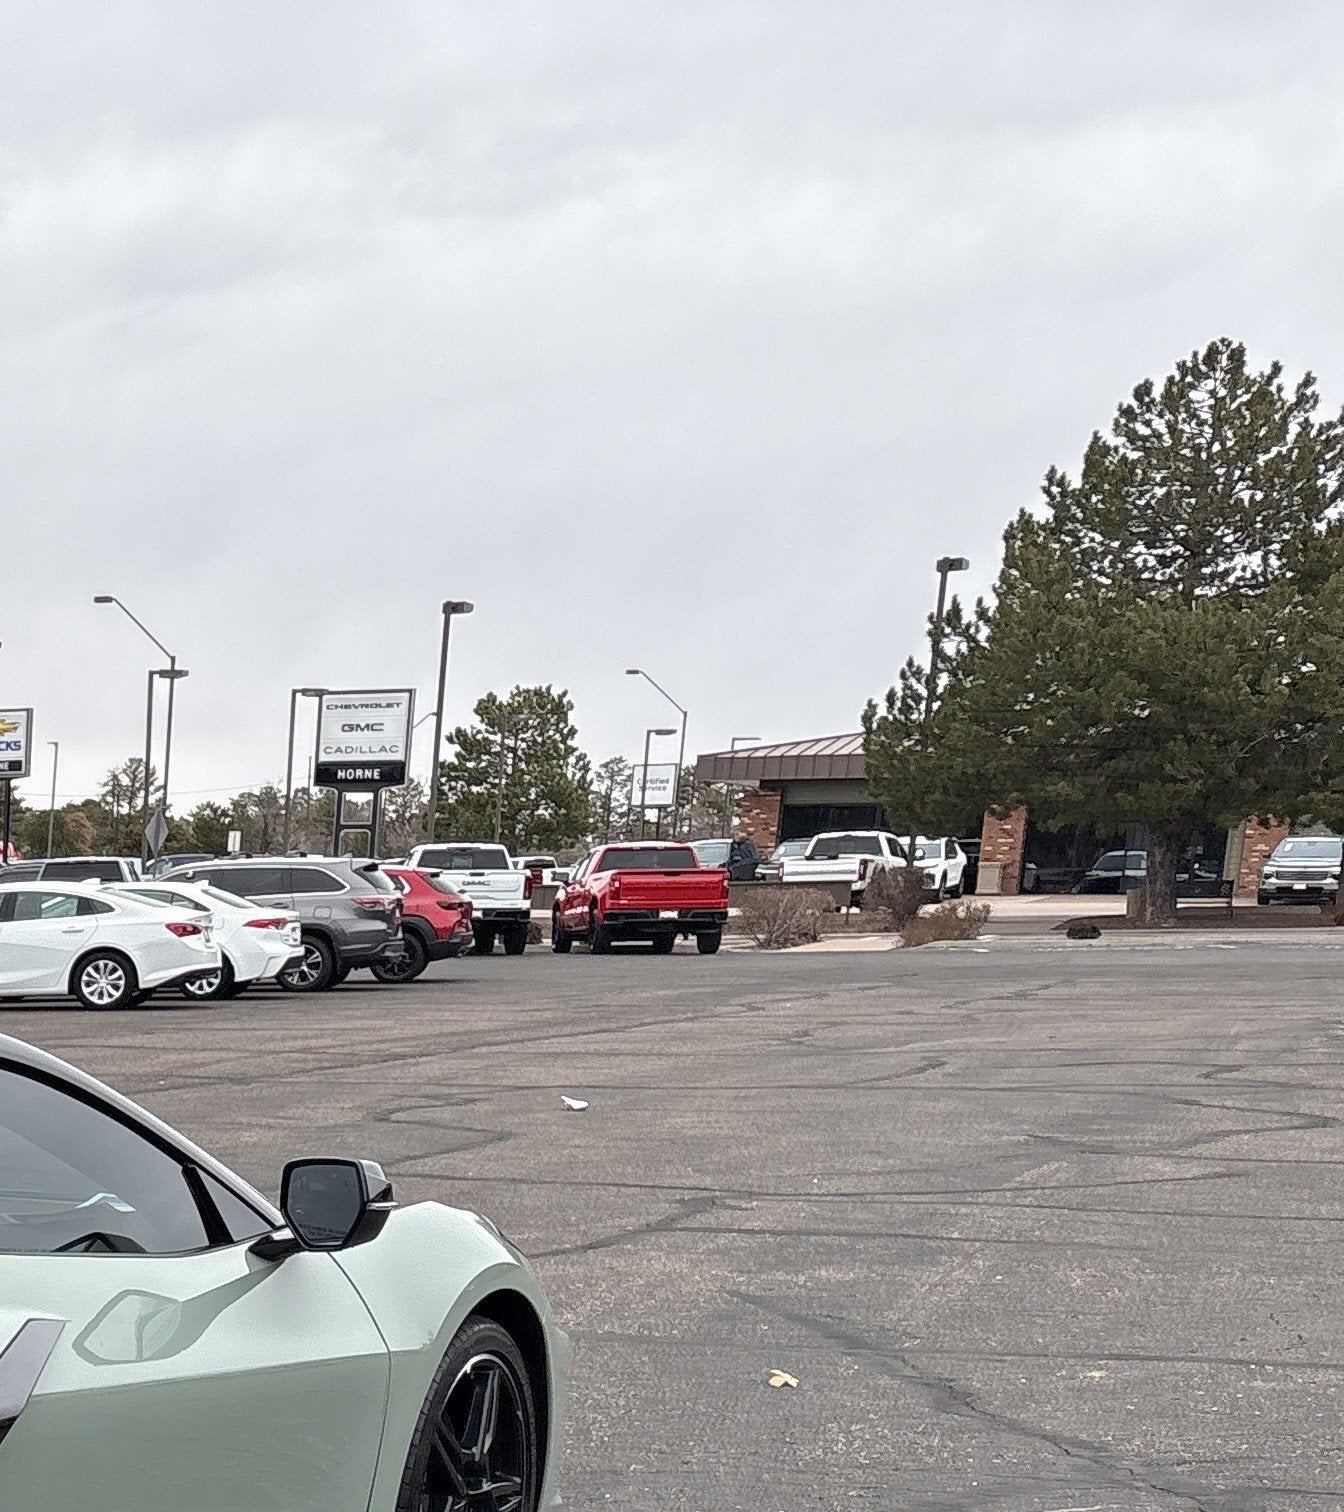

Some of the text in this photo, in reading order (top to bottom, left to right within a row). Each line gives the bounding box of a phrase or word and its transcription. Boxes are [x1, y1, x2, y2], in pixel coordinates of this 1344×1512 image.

[326, 702, 402, 711] CHEVROLET
[341, 723, 384, 733] GMC
[323, 744, 400, 755] CADILLAC
[336, 768, 382, 780] HORNE
